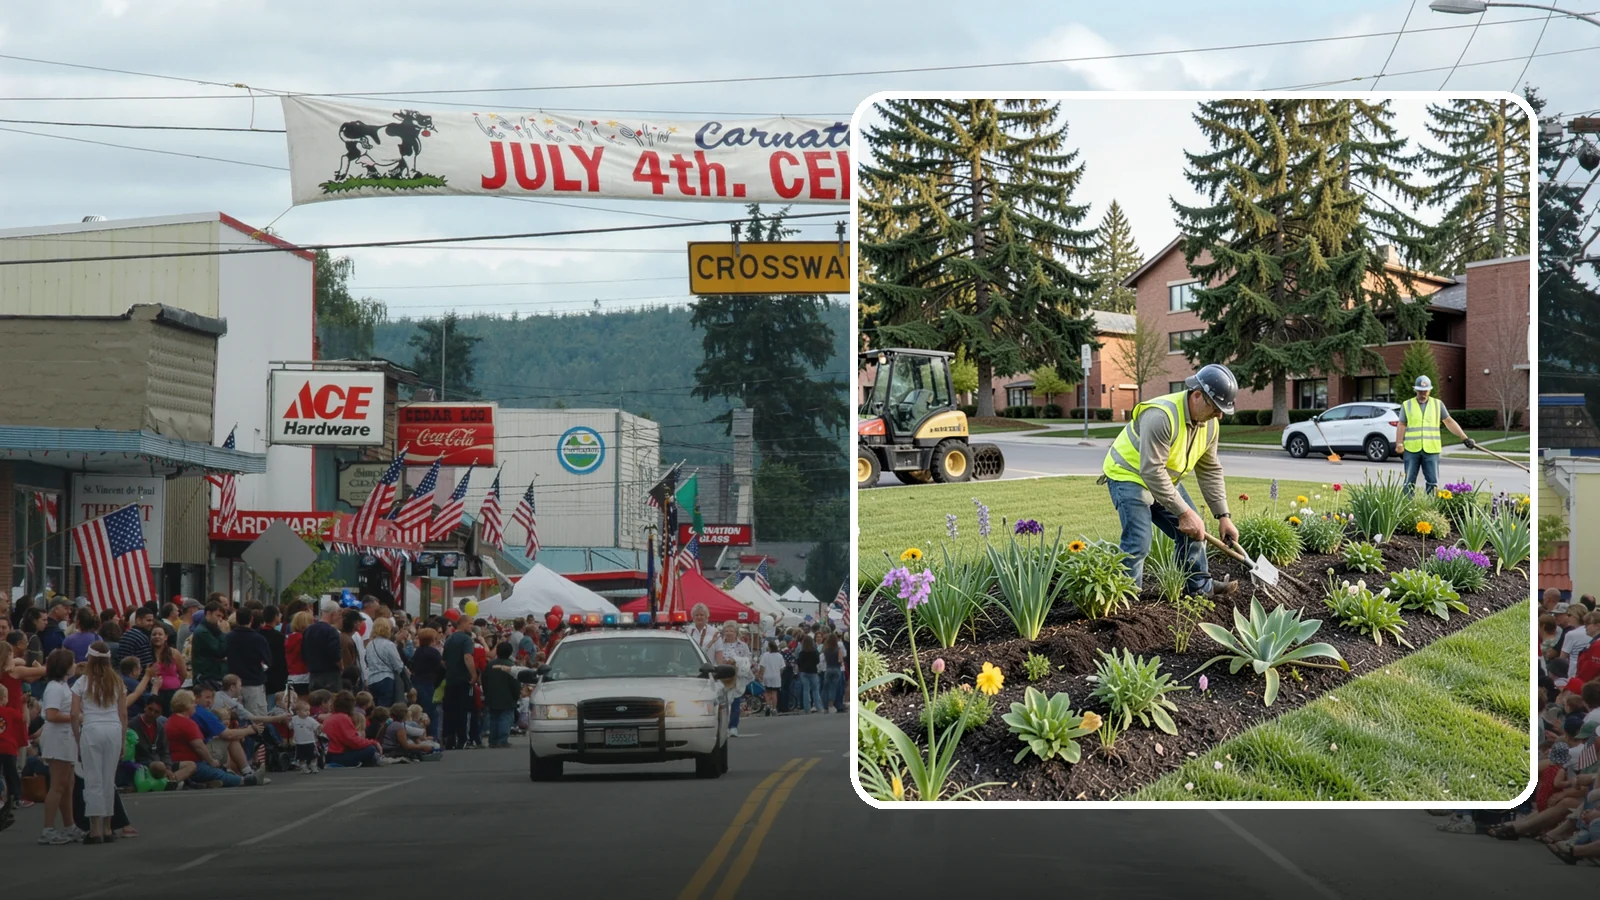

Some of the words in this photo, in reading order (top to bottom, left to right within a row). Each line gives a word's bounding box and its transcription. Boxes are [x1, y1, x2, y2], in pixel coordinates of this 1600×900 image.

[481, 141, 605, 192] JULY
[632, 150, 746, 198] 4th.
[697, 254, 850, 280] CROSSWA
[282, 379, 374, 420] ACE
[405, 409, 452, 421] CEDAR
[283, 420, 371, 437] Hardware
[353, 466, 386, 480] Simpl
[96, 485, 124, 494] Vincent
[126, 486, 136, 494] de
[138, 486, 155, 495] Paul
[81, 503, 153, 522] THT
[688, 526, 741, 535] CRNATION
[699, 535, 730, 543] GLASS
